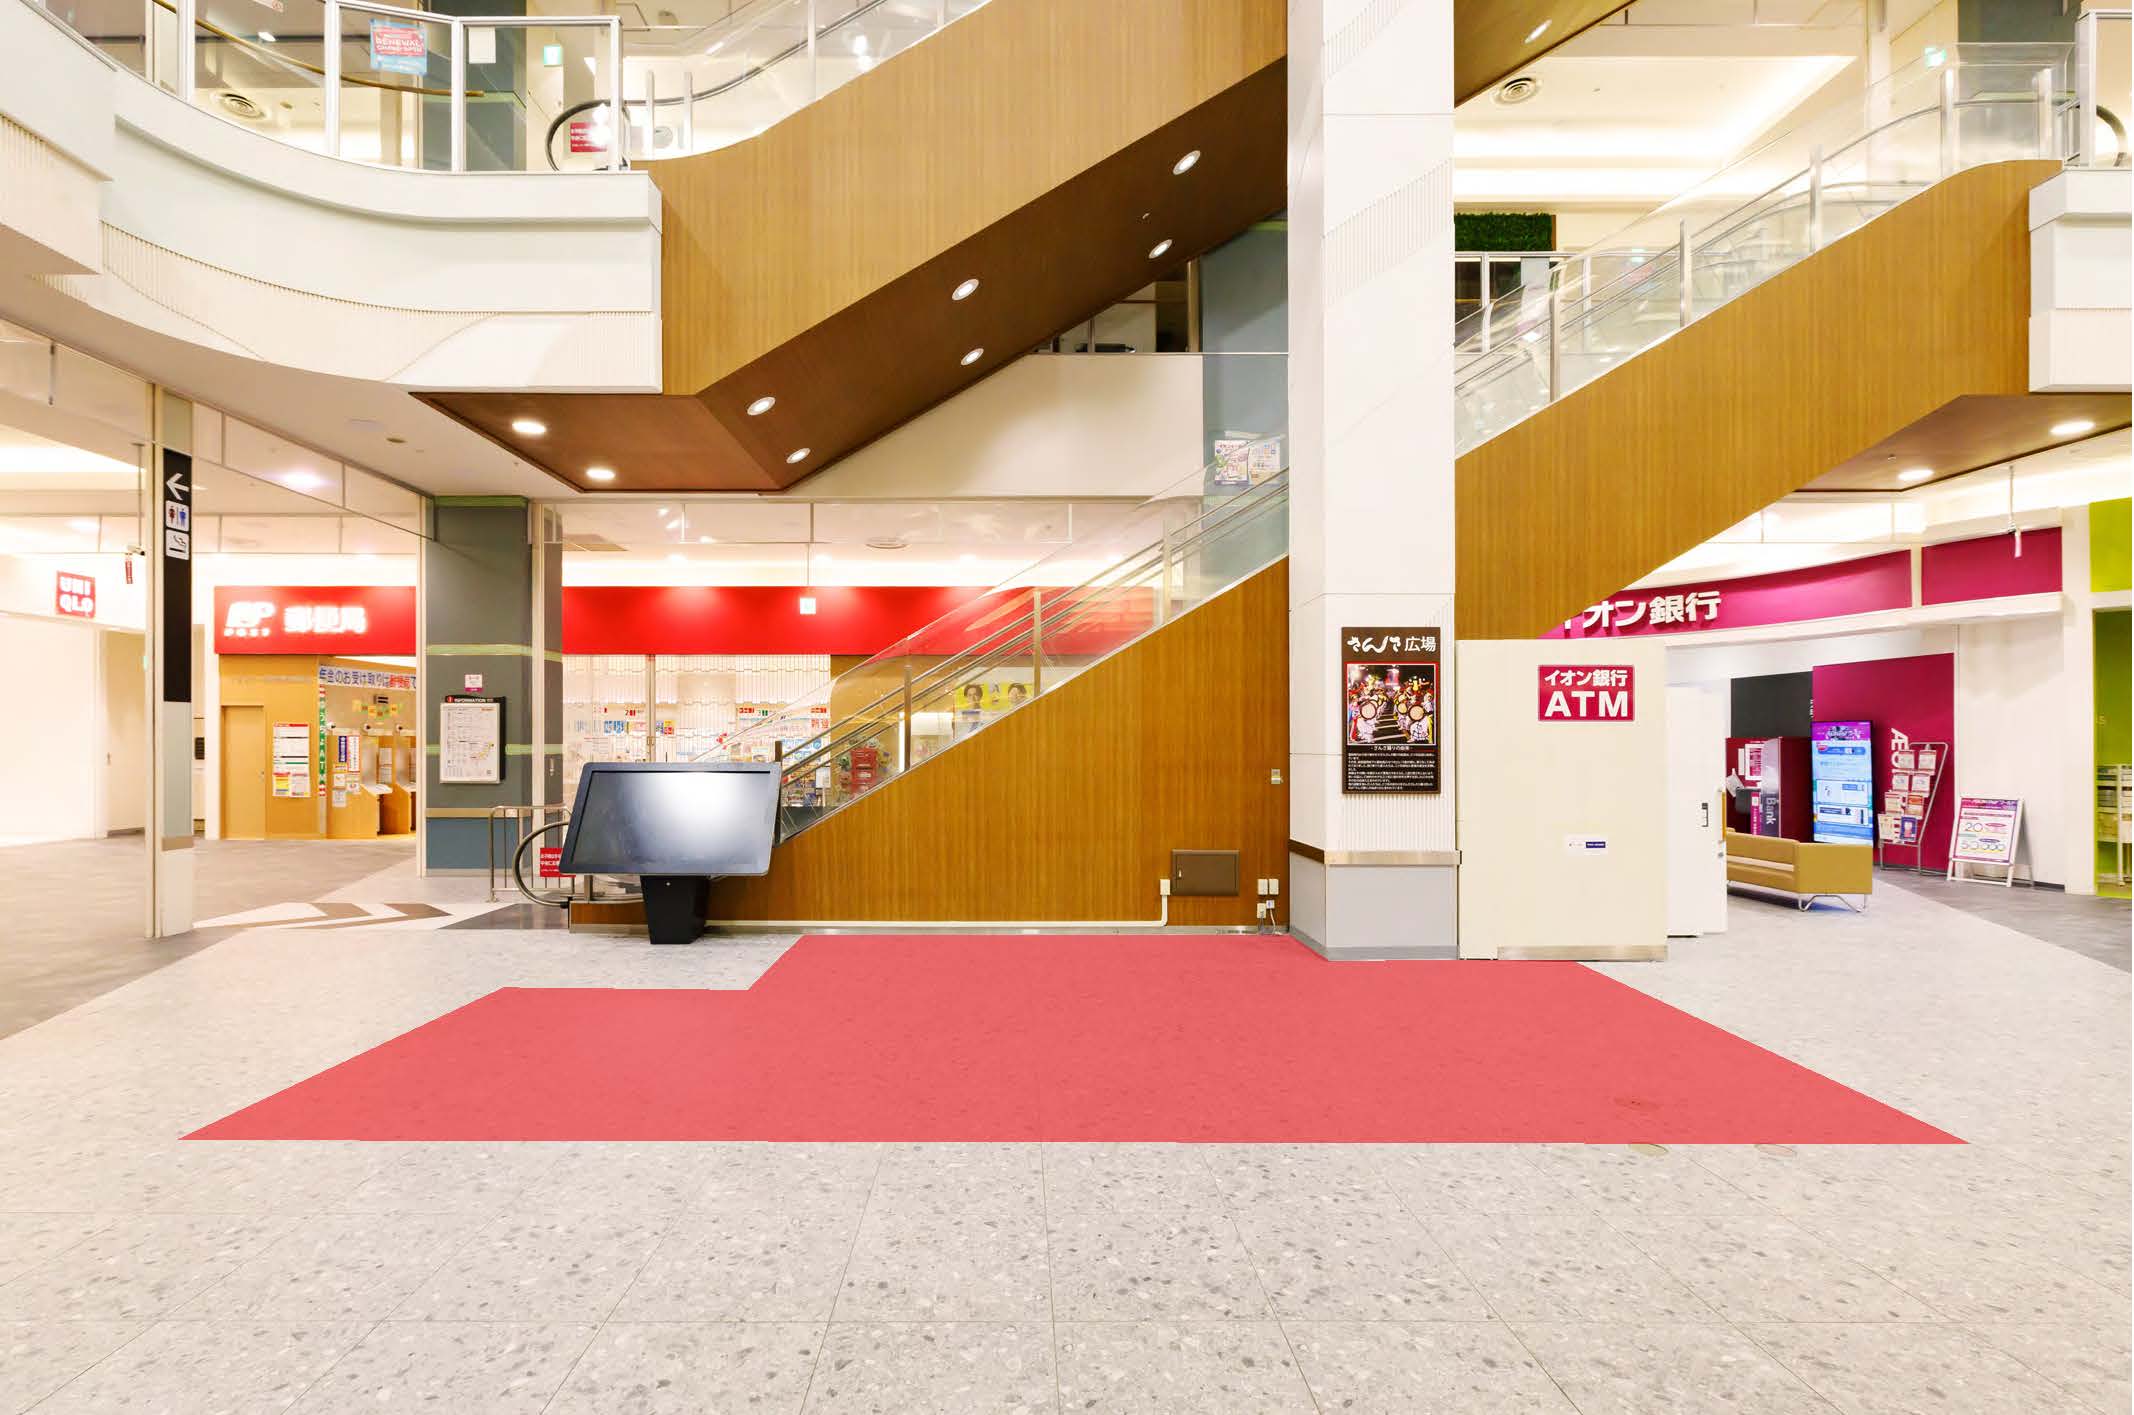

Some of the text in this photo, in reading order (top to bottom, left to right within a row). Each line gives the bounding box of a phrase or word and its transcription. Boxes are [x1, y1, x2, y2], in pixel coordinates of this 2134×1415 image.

[60, 577, 91, 595] UNI
[60, 594, 93, 613] QLO
[1564, 591, 1722, 630] オン銀行
[1544, 669, 1628, 687] イオン銀行
[1544, 690, 1628, 717] ATM
[1765, 797, 1777, 825] Bank
